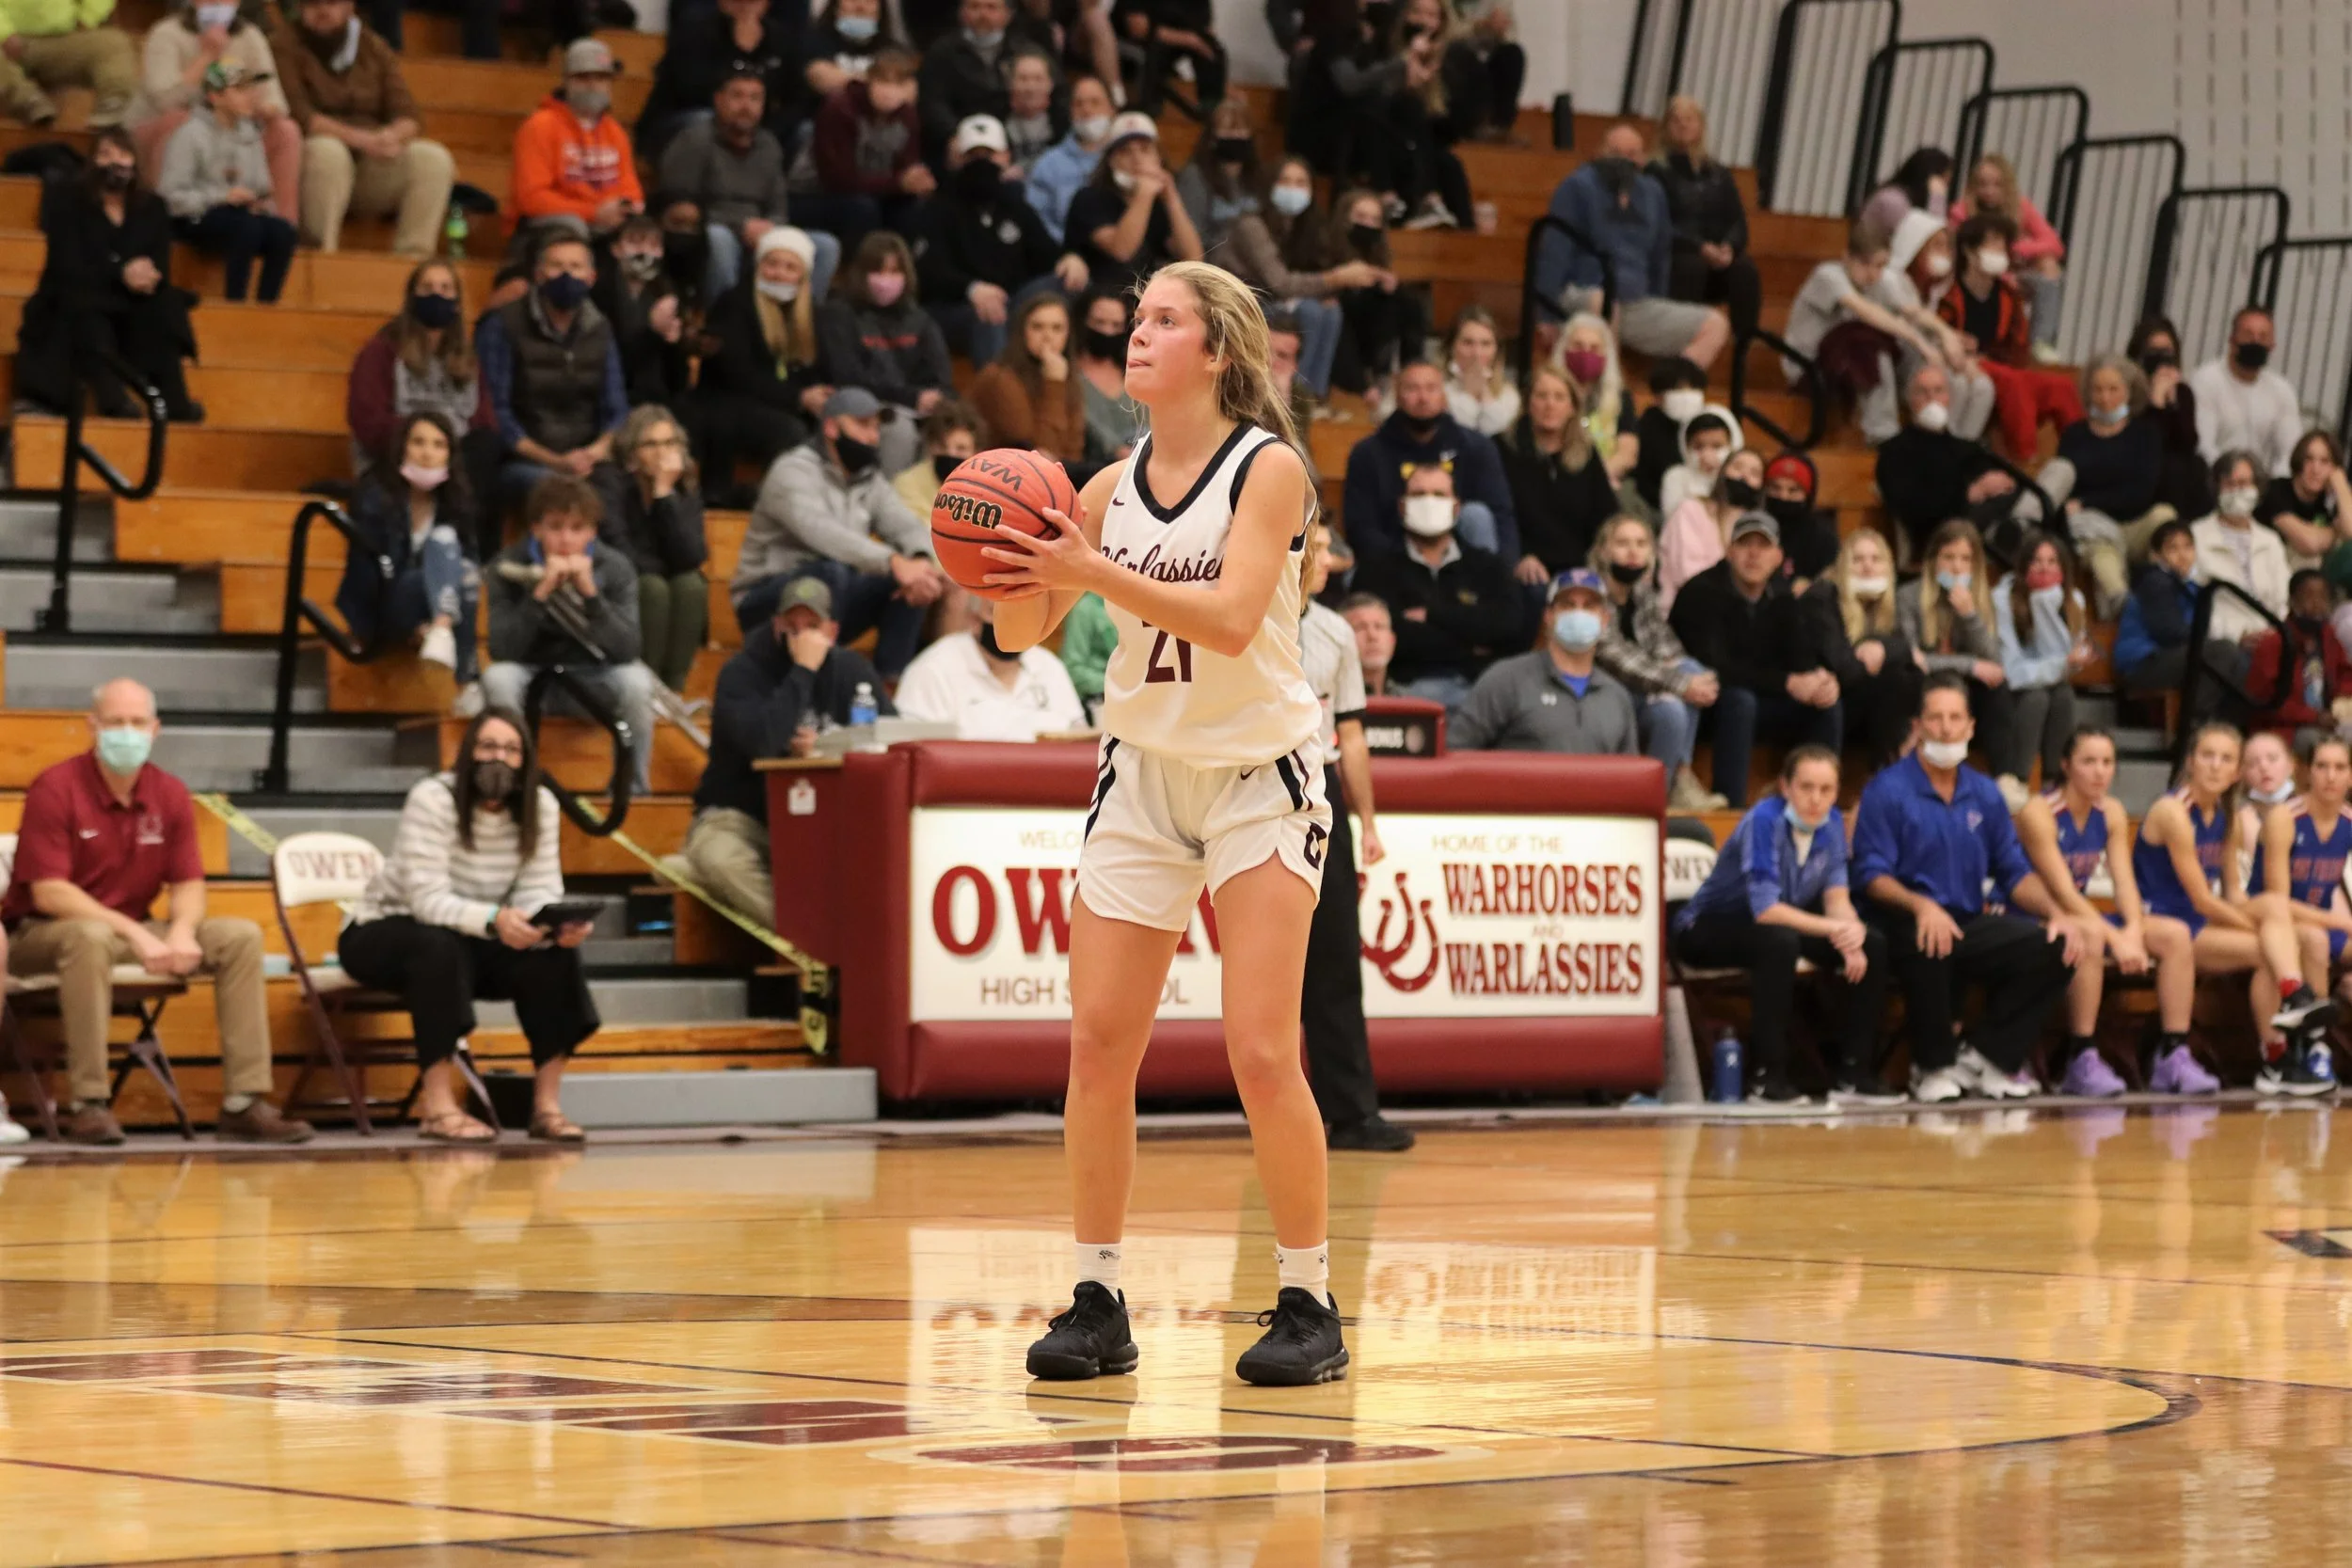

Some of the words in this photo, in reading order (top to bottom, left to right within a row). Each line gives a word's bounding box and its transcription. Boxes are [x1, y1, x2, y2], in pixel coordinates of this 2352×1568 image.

[934, 494, 1003, 530] Wilson
[1102, 544, 1224, 583] Wrlassie
[1142, 620, 1192, 683] 21
[1432, 834, 1490, 853] HOME
[1496, 834, 1519, 853] OF
[1528, 834, 1563, 853] THE
[287, 850, 376, 879] OWEN
[1442, 863, 1643, 916] WARHORSES
[1532, 925, 1564, 938] AND
[1445, 942, 1643, 994] WARLASSIES
[981, 976, 1056, 1006] HIGH
